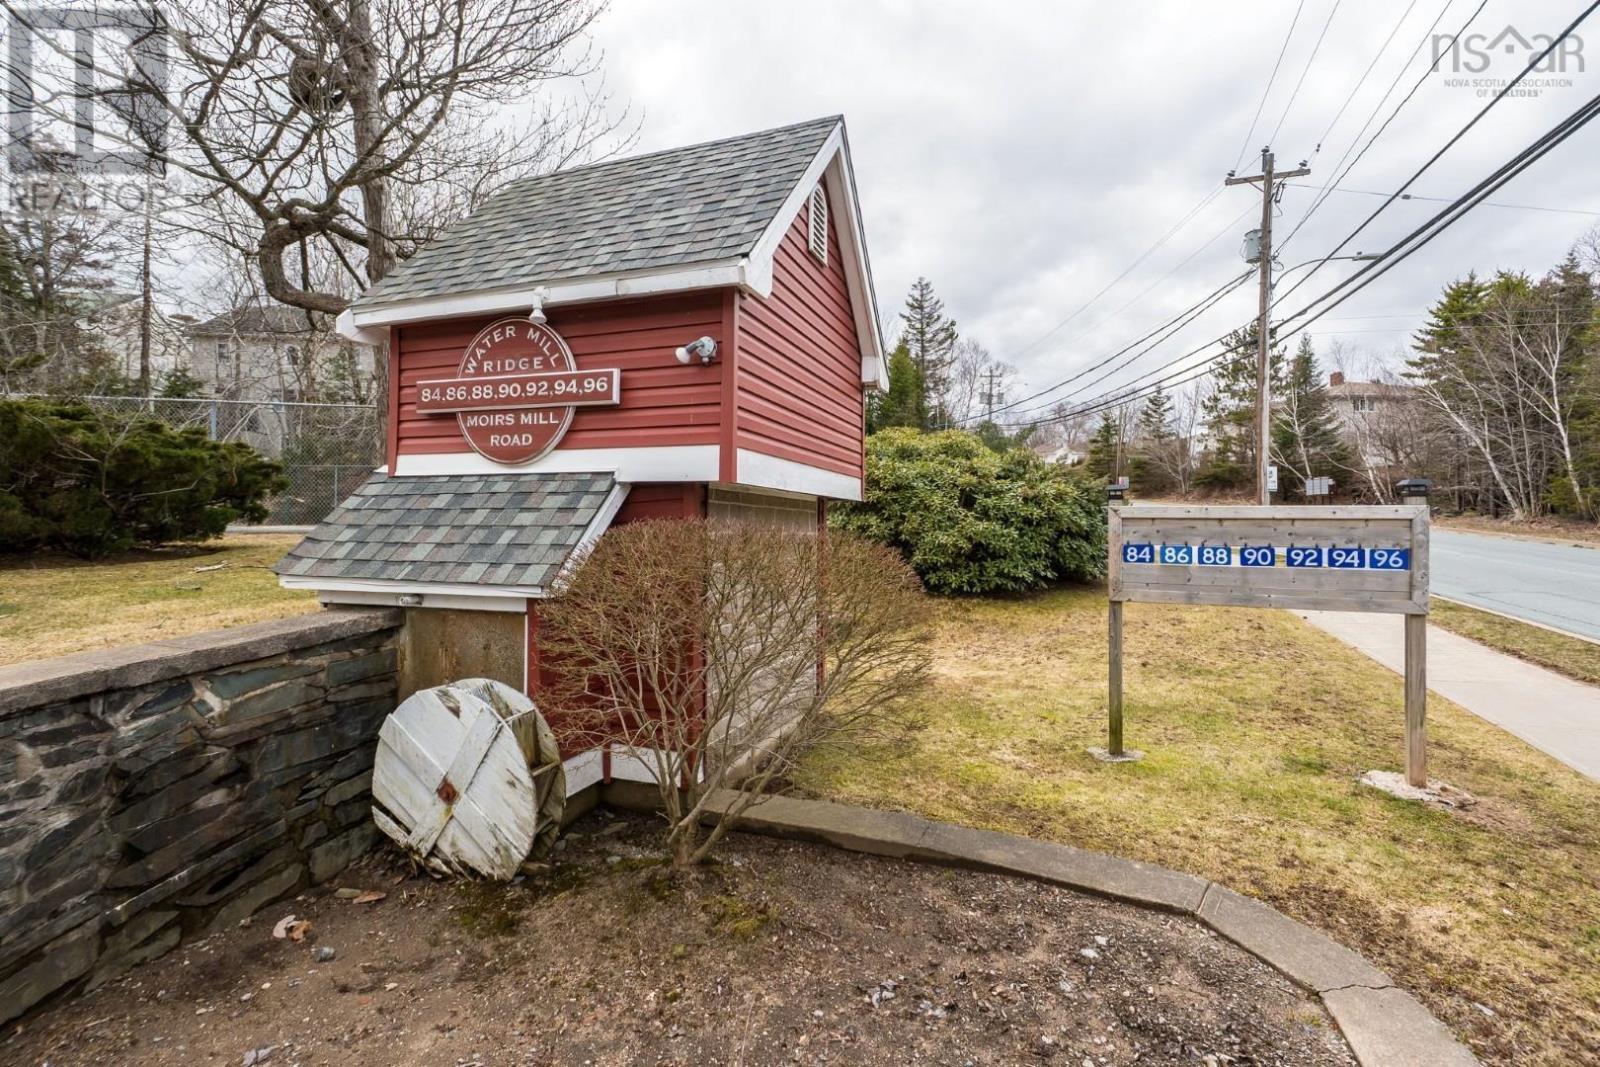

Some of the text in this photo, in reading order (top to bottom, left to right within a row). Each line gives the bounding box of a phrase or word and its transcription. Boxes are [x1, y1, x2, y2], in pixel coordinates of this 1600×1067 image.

[465, 325, 562, 375] WATER MILL
[483, 356, 543, 373] RIDGE
[466, 411, 559, 427] MOIRS MILL
[490, 433, 533, 447] ROAD
[1126, 545, 1403, 567] 84 86 88 90 92 94 96
